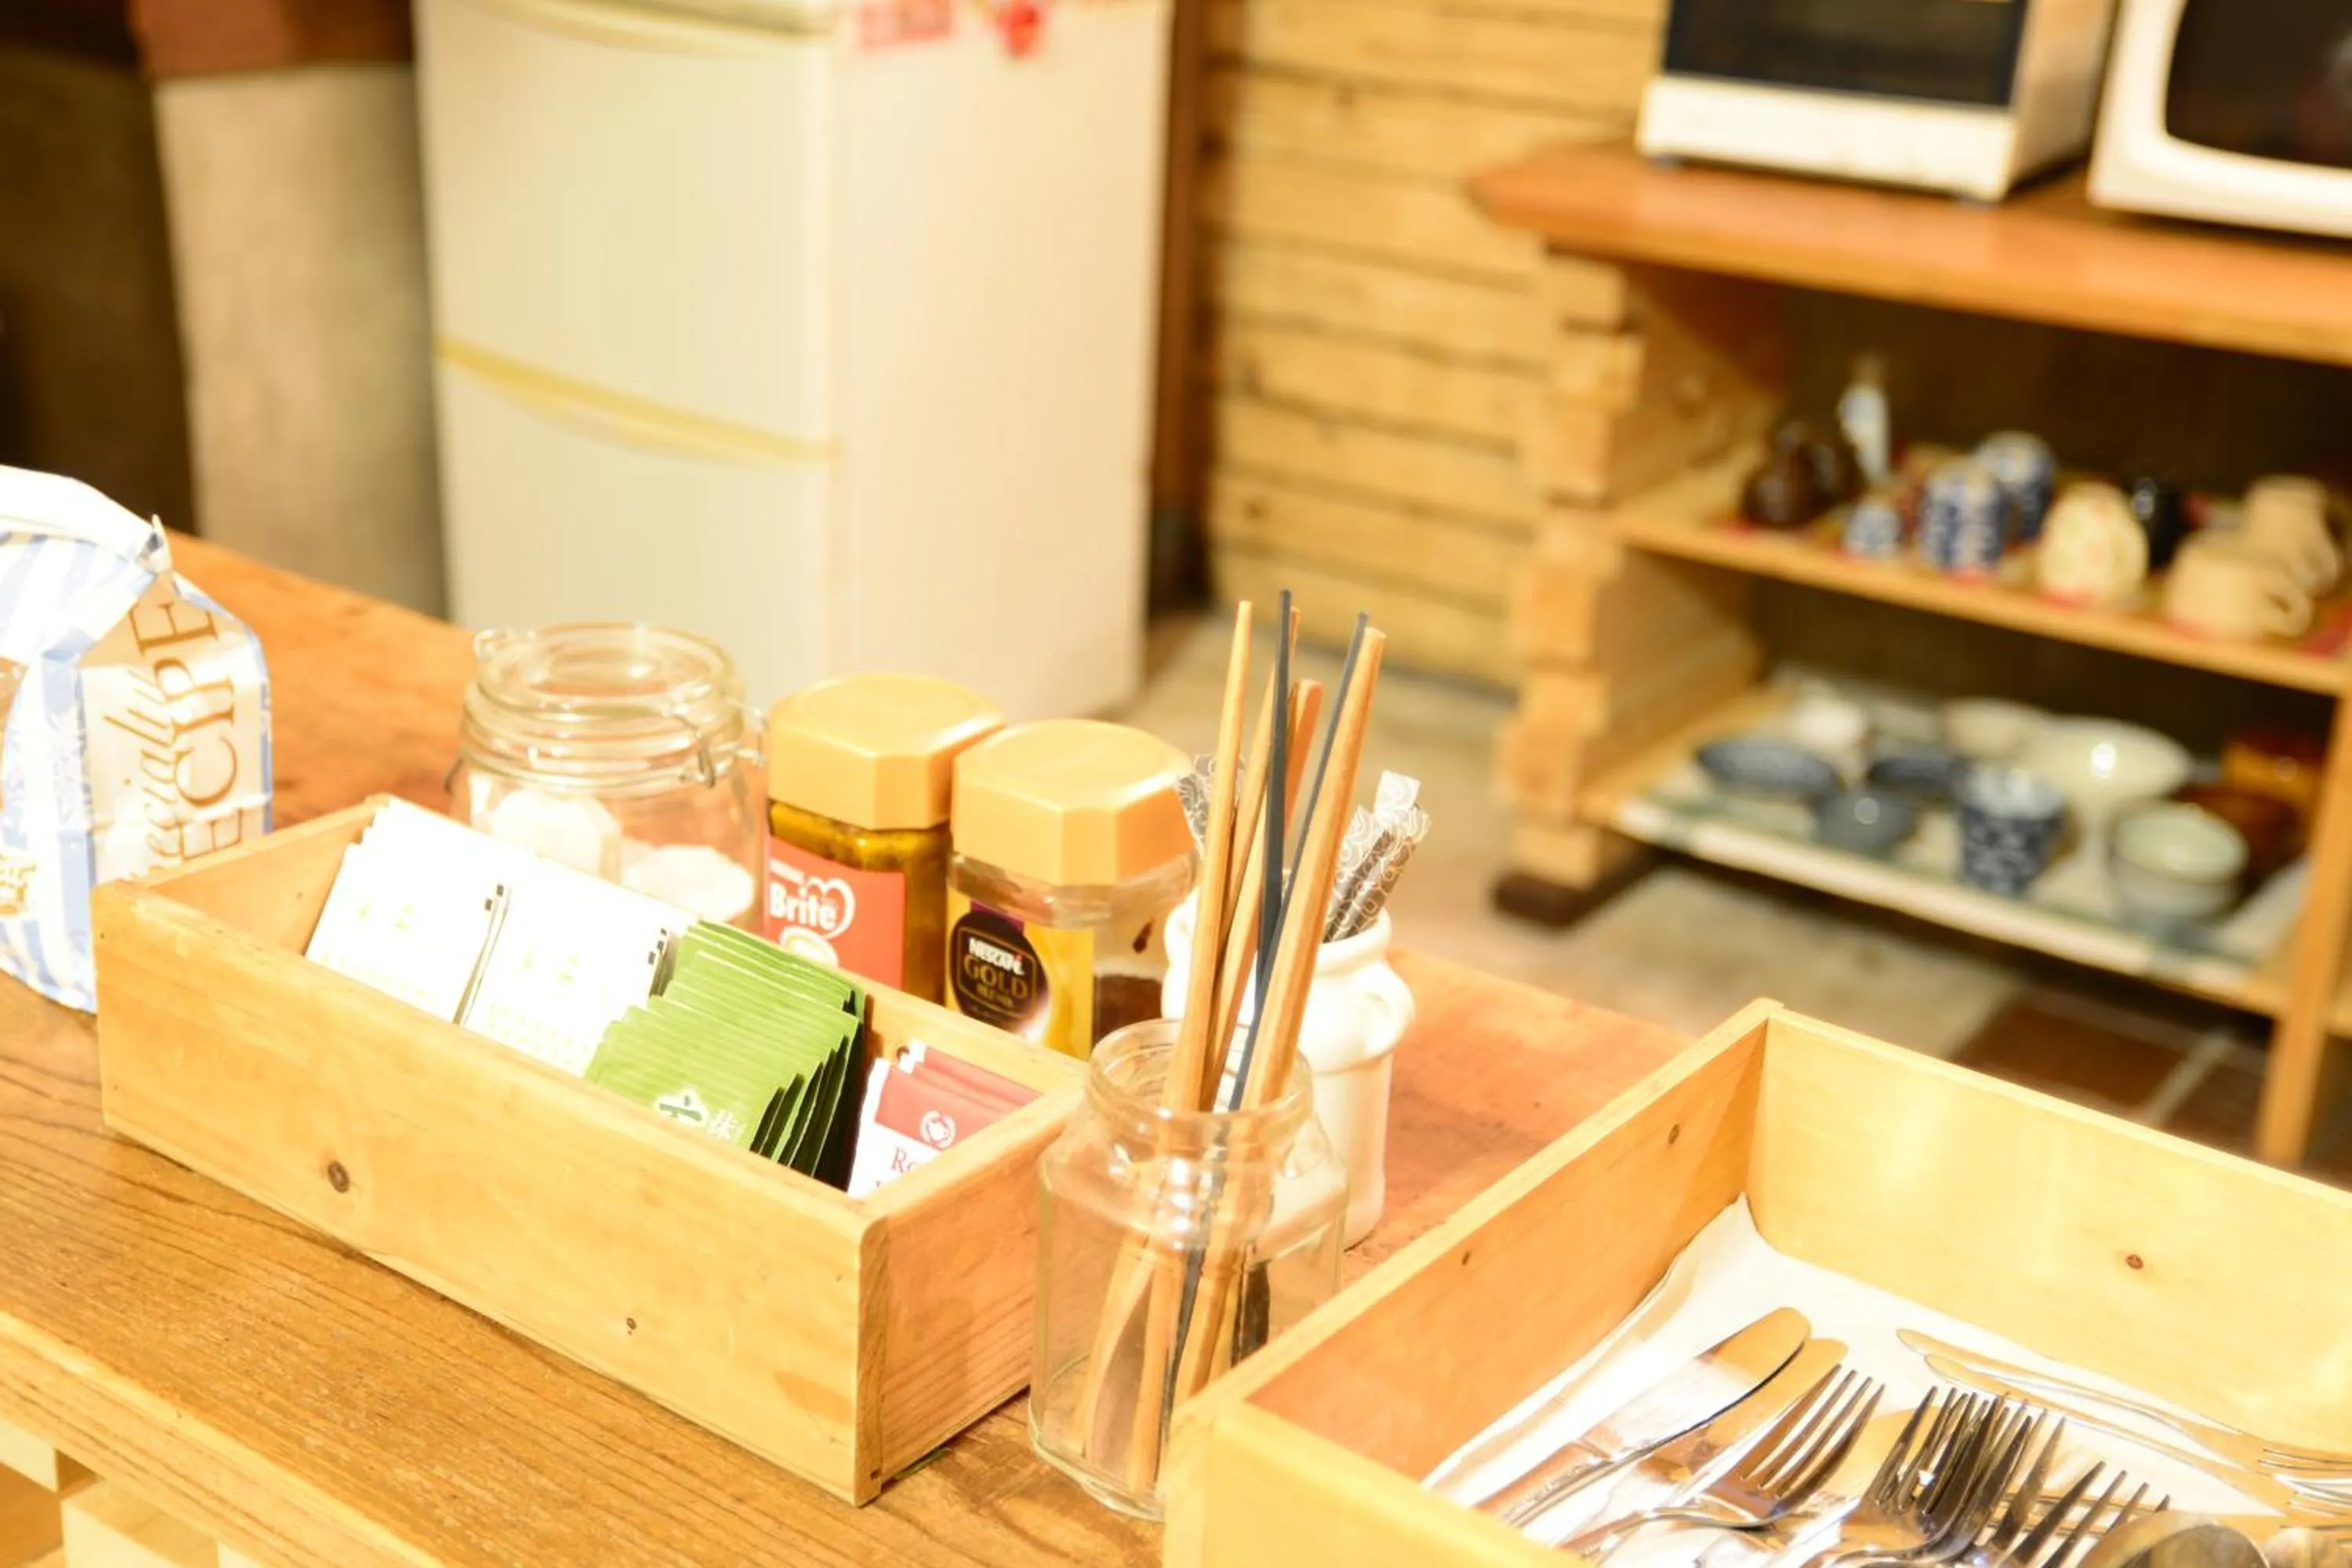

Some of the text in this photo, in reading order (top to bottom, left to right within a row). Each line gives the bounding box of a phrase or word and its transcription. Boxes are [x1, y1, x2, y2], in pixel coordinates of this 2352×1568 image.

[128, 599, 243, 861] ECIPE
[769, 880, 837, 931] Brite
[964, 954, 1028, 1000] GOLD
